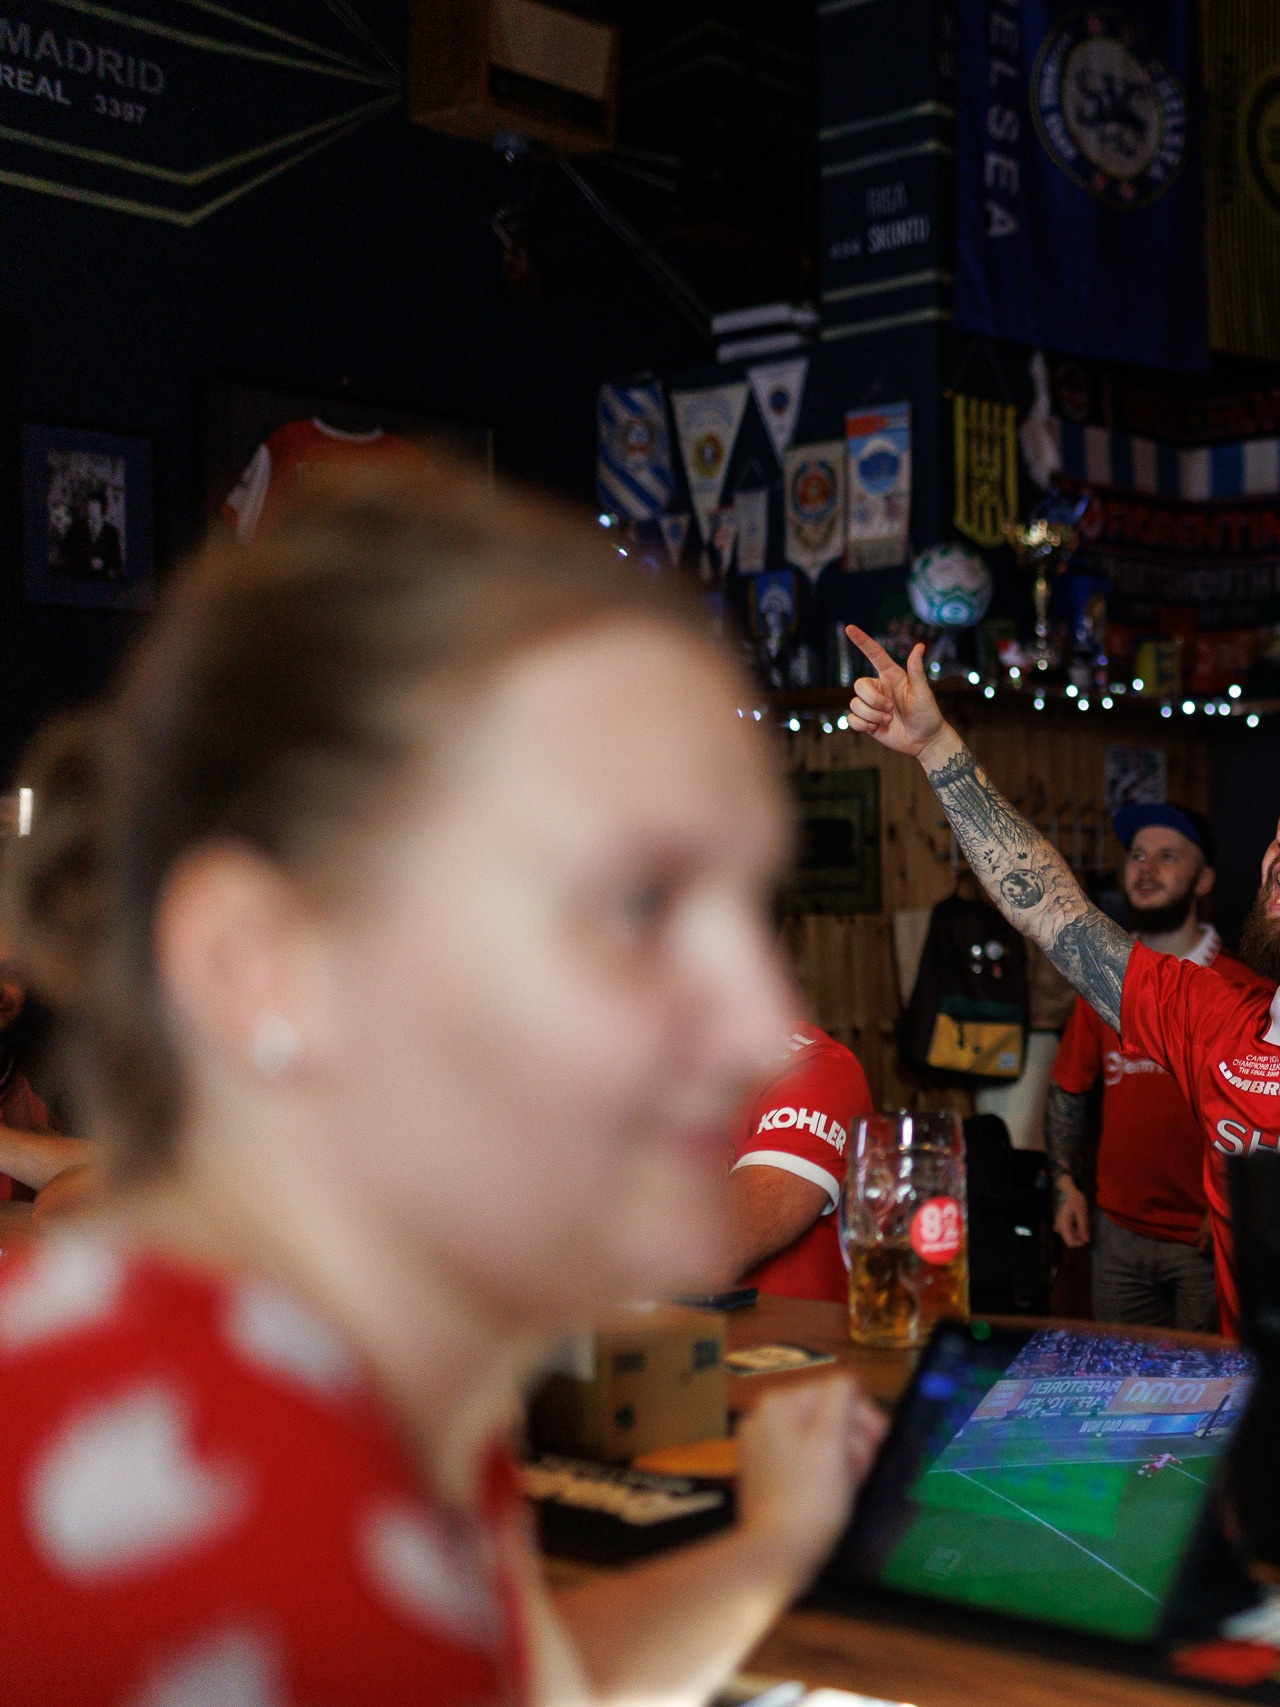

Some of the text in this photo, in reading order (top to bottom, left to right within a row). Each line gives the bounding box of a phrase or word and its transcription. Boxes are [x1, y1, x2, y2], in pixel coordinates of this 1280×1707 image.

[0, 17, 166, 95] MADRID
[0, 62, 73, 107] REAL
[983, 0, 1021, 239] ELSEA
[1232, 1058, 1269, 1070] CHAMPIONS
[1239, 1066, 1250, 1075] THE
[1250, 1069, 1265, 1077] FINAL
[1246, 1054, 1269, 1063] CAMP
[756, 1107, 847, 1156] KOHLER
